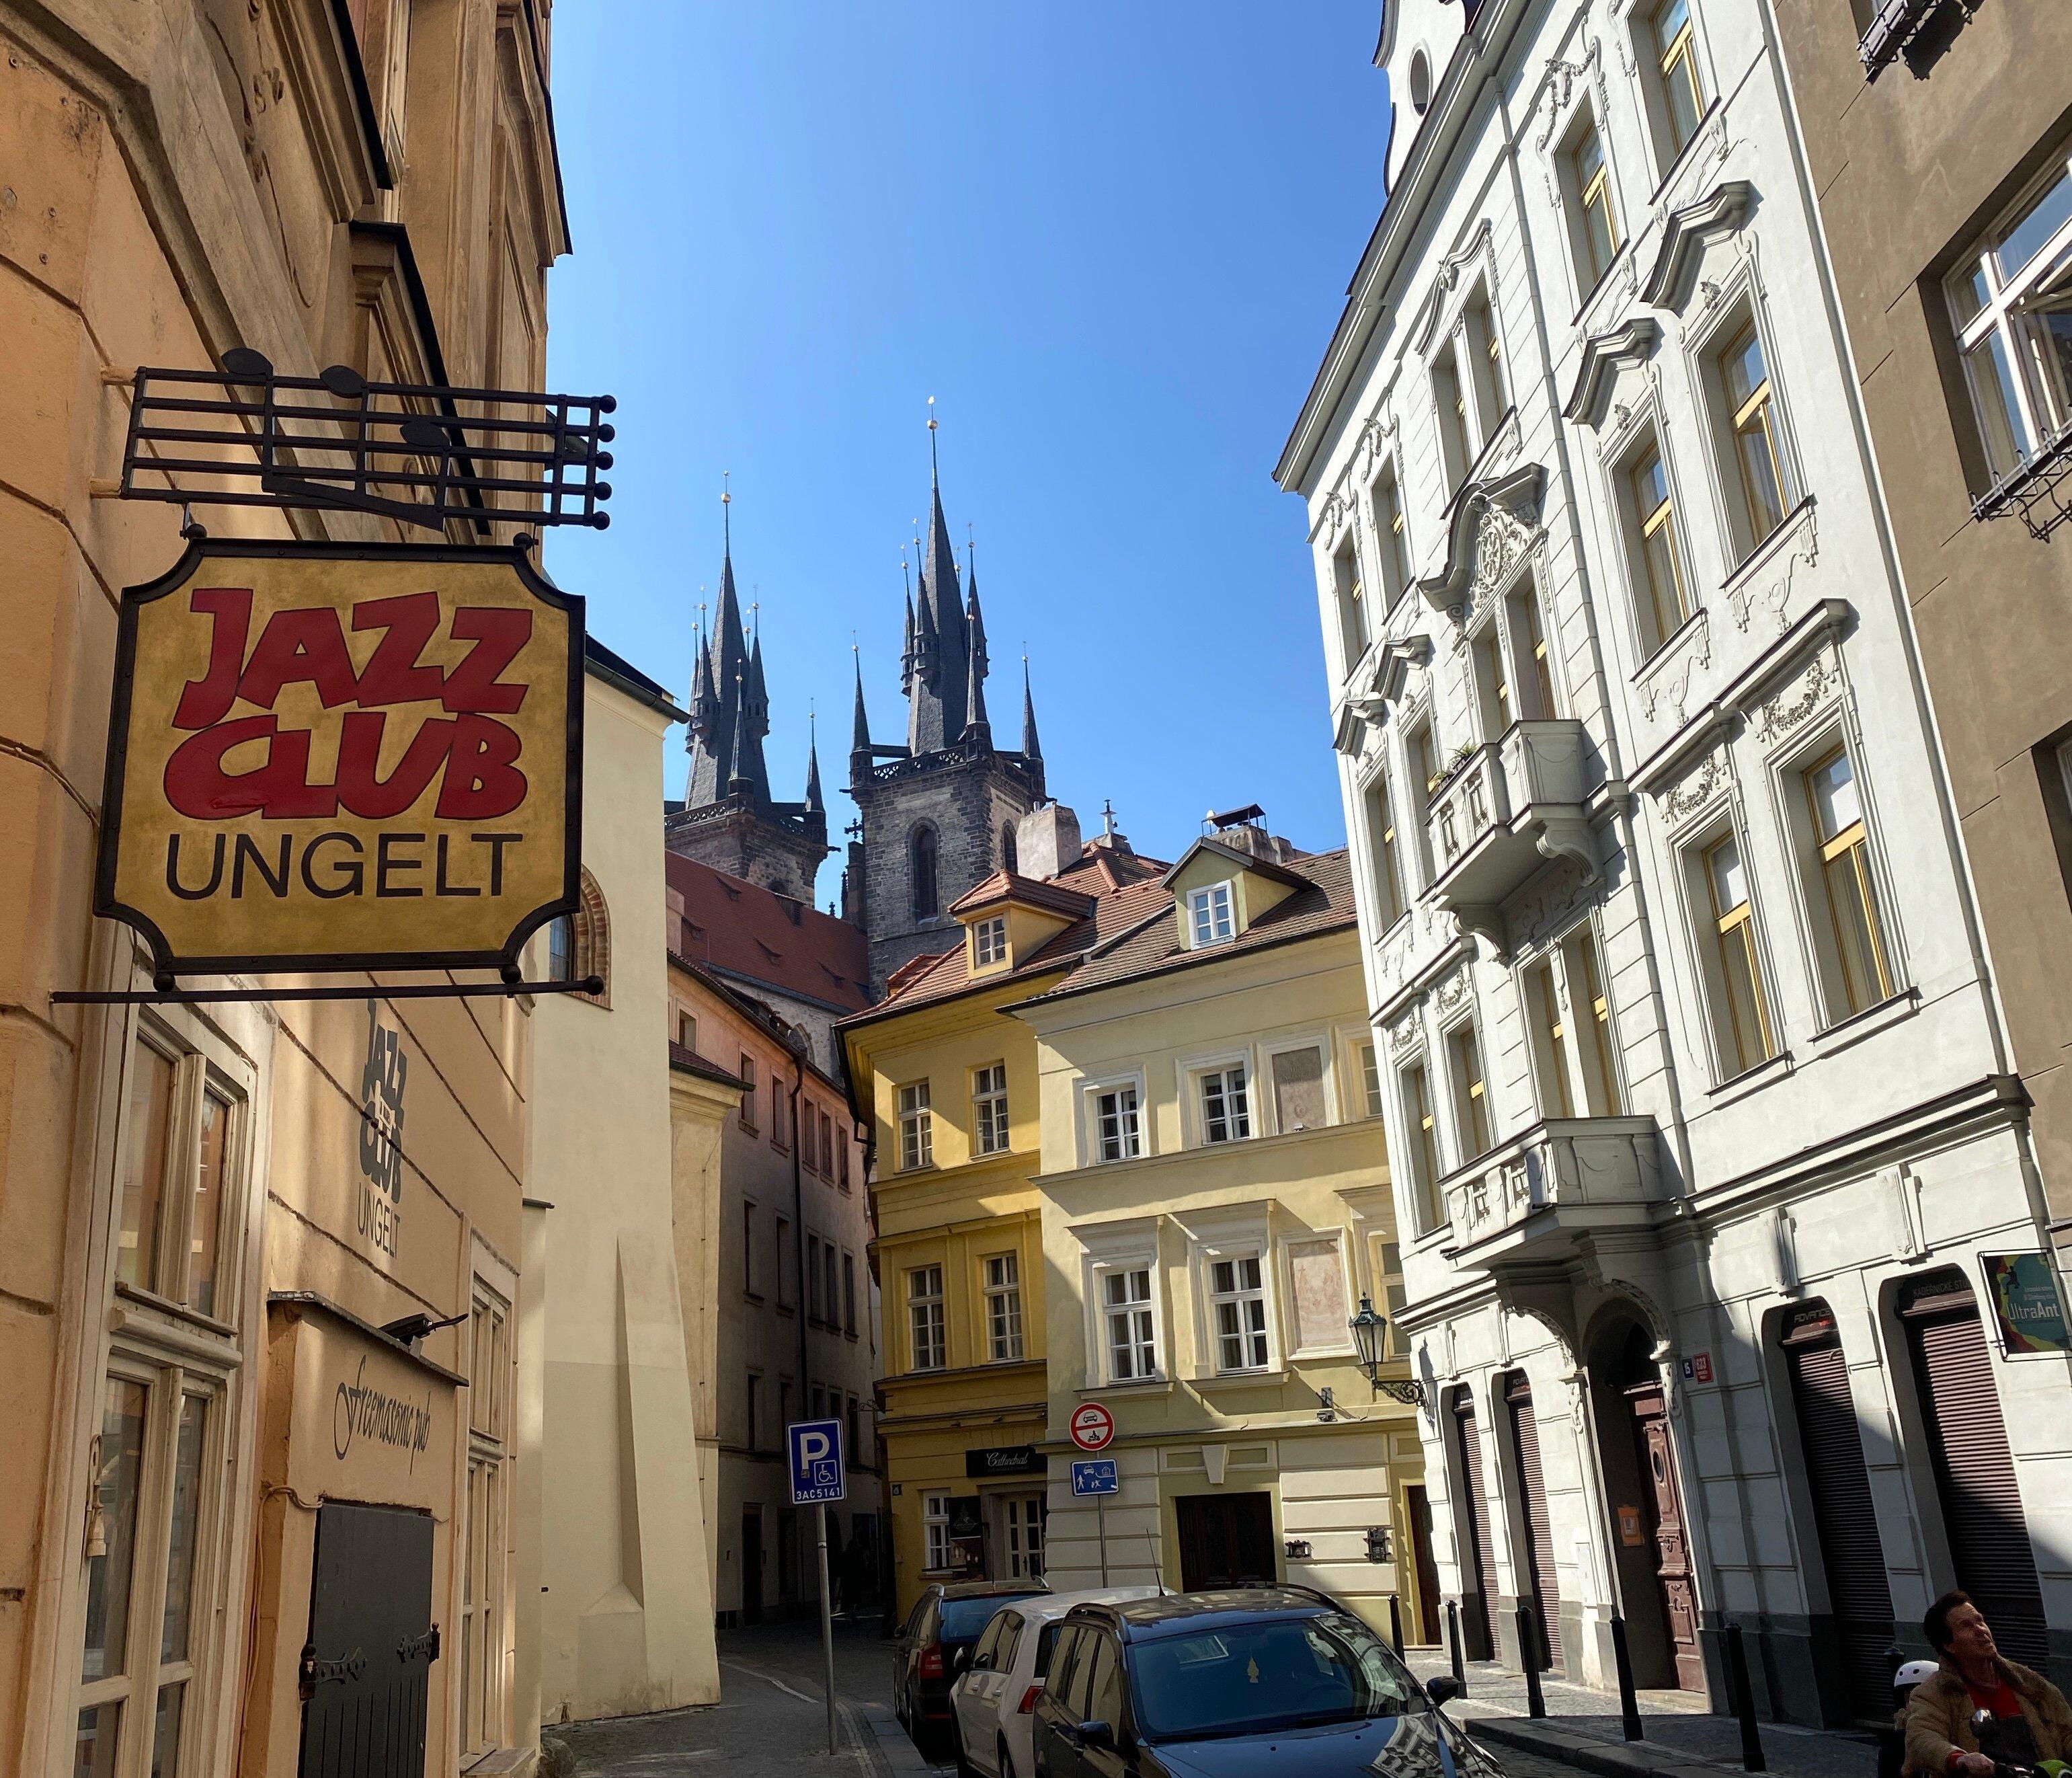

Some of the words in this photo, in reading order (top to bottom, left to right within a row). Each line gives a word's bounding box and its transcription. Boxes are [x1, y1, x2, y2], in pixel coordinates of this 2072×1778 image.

[172, 588, 533, 730] JAZZ
[163, 711, 528, 820] CLUB
[166, 833, 523, 900] UNGELT
[362, 999, 407, 1131] JAZZ
[360, 1101, 402, 1204] CLUB
[358, 1182, 400, 1260] UNGELT
[2006, 1301, 2060, 1319] UltraAnt
[409, 1391, 430, 1476] pub
[800, 1432, 830, 1471] P
[986, 1452, 1029, 1467] Cathedral
[796, 1487, 840, 1500] 3AC5141
